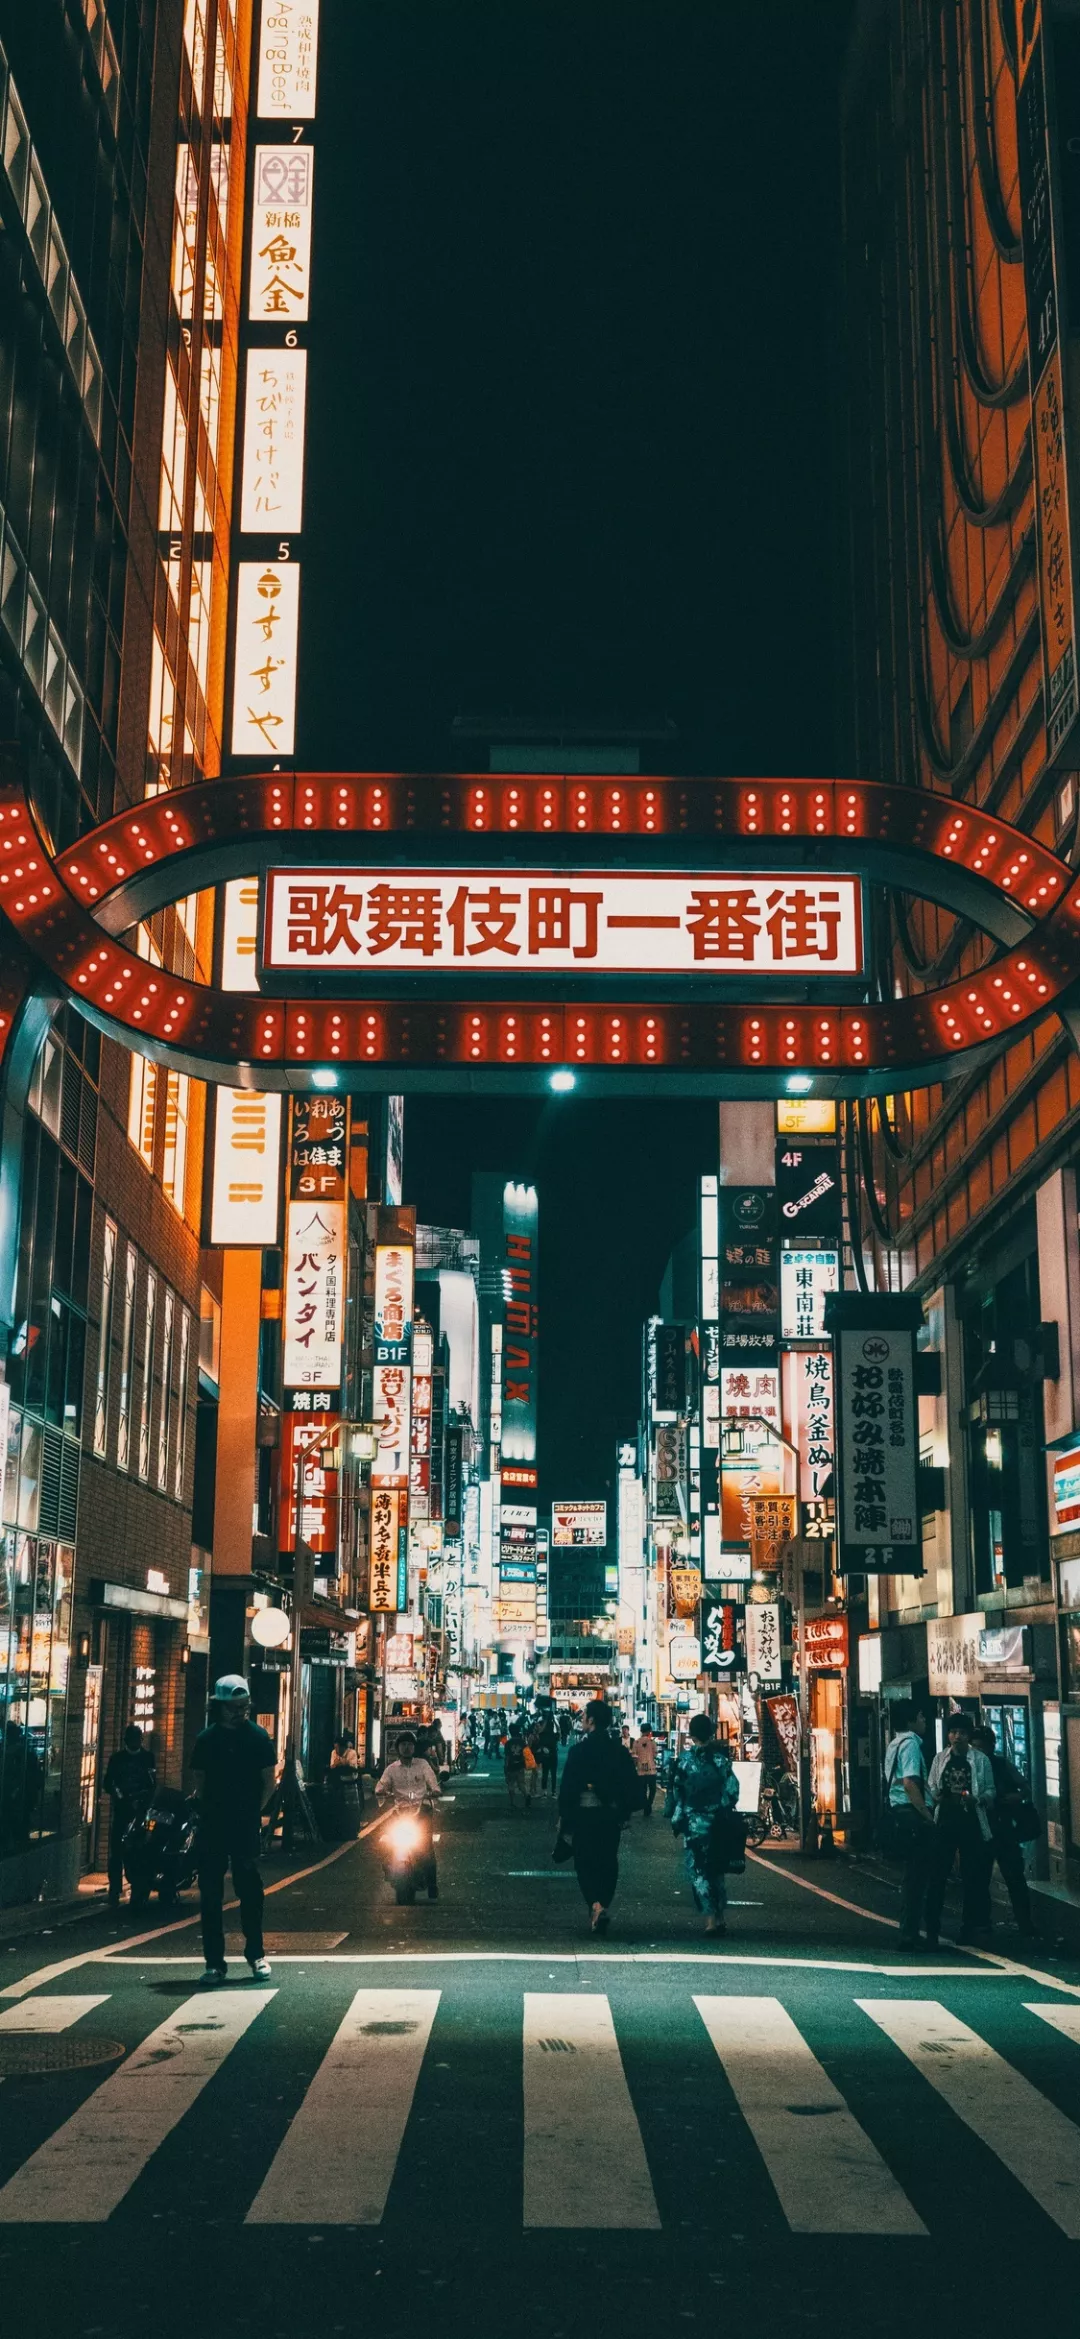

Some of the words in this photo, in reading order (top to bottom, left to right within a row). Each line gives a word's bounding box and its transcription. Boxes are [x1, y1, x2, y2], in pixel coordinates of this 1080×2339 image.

[292, 126, 304, 143] 7
[264, 211, 301, 228] 新橋
[258, 234, 304, 313] 魚金
[285, 329, 297, 347] 6
[253, 368, 283, 513] ちびすけバル
[278, 543, 290, 560] 5
[246, 604, 286, 750] すずや
[287, 883, 842, 962] 歌舞伎町一番街
[785, 1115, 806, 1128] 5F
[293, 1101, 311, 1167] いろは
[327, 1099, 346, 1166] あづま
[781, 1152, 803, 1167] 4F
[299, 1176, 337, 1192] 3F
[294, 1253, 321, 1348] バンタイ
[324, 1253, 337, 1342] タイ国料理専門店
[383, 1251, 405, 1342] まぐろ商店
[796, 1267, 815, 1336] 東南荘
[723, 1334, 775, 1347] 酒場牧場
[377, 1347, 408, 1361] B1F
[301, 1371, 323, 1382] 3F
[725, 1373, 777, 1398] 焼肉
[292, 1392, 331, 1410] 焼肉
[805, 1354, 832, 1498] 焼鳥釜めし
[851, 1364, 888, 1532] お好み焼本陣
[380, 1476, 400, 1487] 4F
[754, 1515, 791, 1527] 客引き
[754, 1529, 792, 1541] に注意
[864, 1547, 894, 1564] 2F
[758, 1610, 779, 1673] お好み焼き
